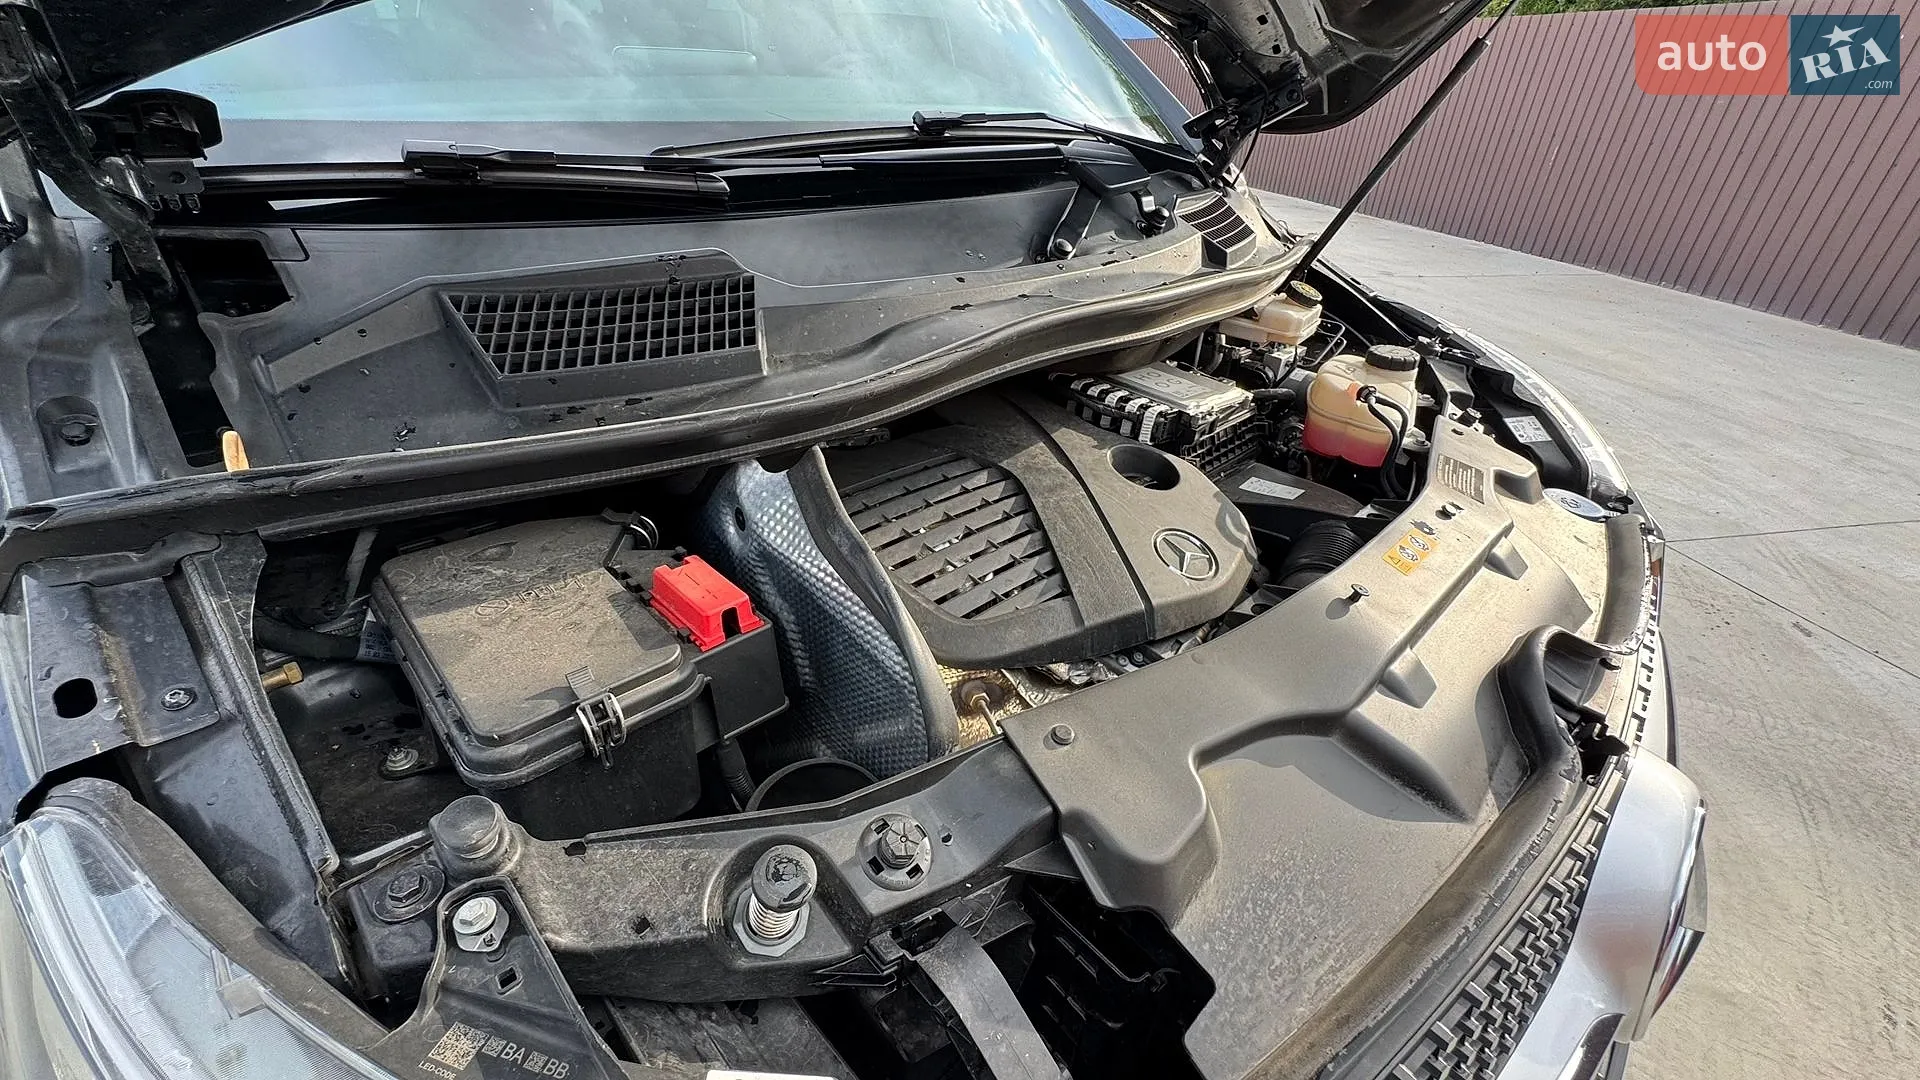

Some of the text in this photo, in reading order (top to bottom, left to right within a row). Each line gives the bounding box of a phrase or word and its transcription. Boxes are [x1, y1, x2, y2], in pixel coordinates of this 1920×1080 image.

[418, 1060, 457, 1080] LED-CODE
[501, 1042, 570, 1080] BA BB
